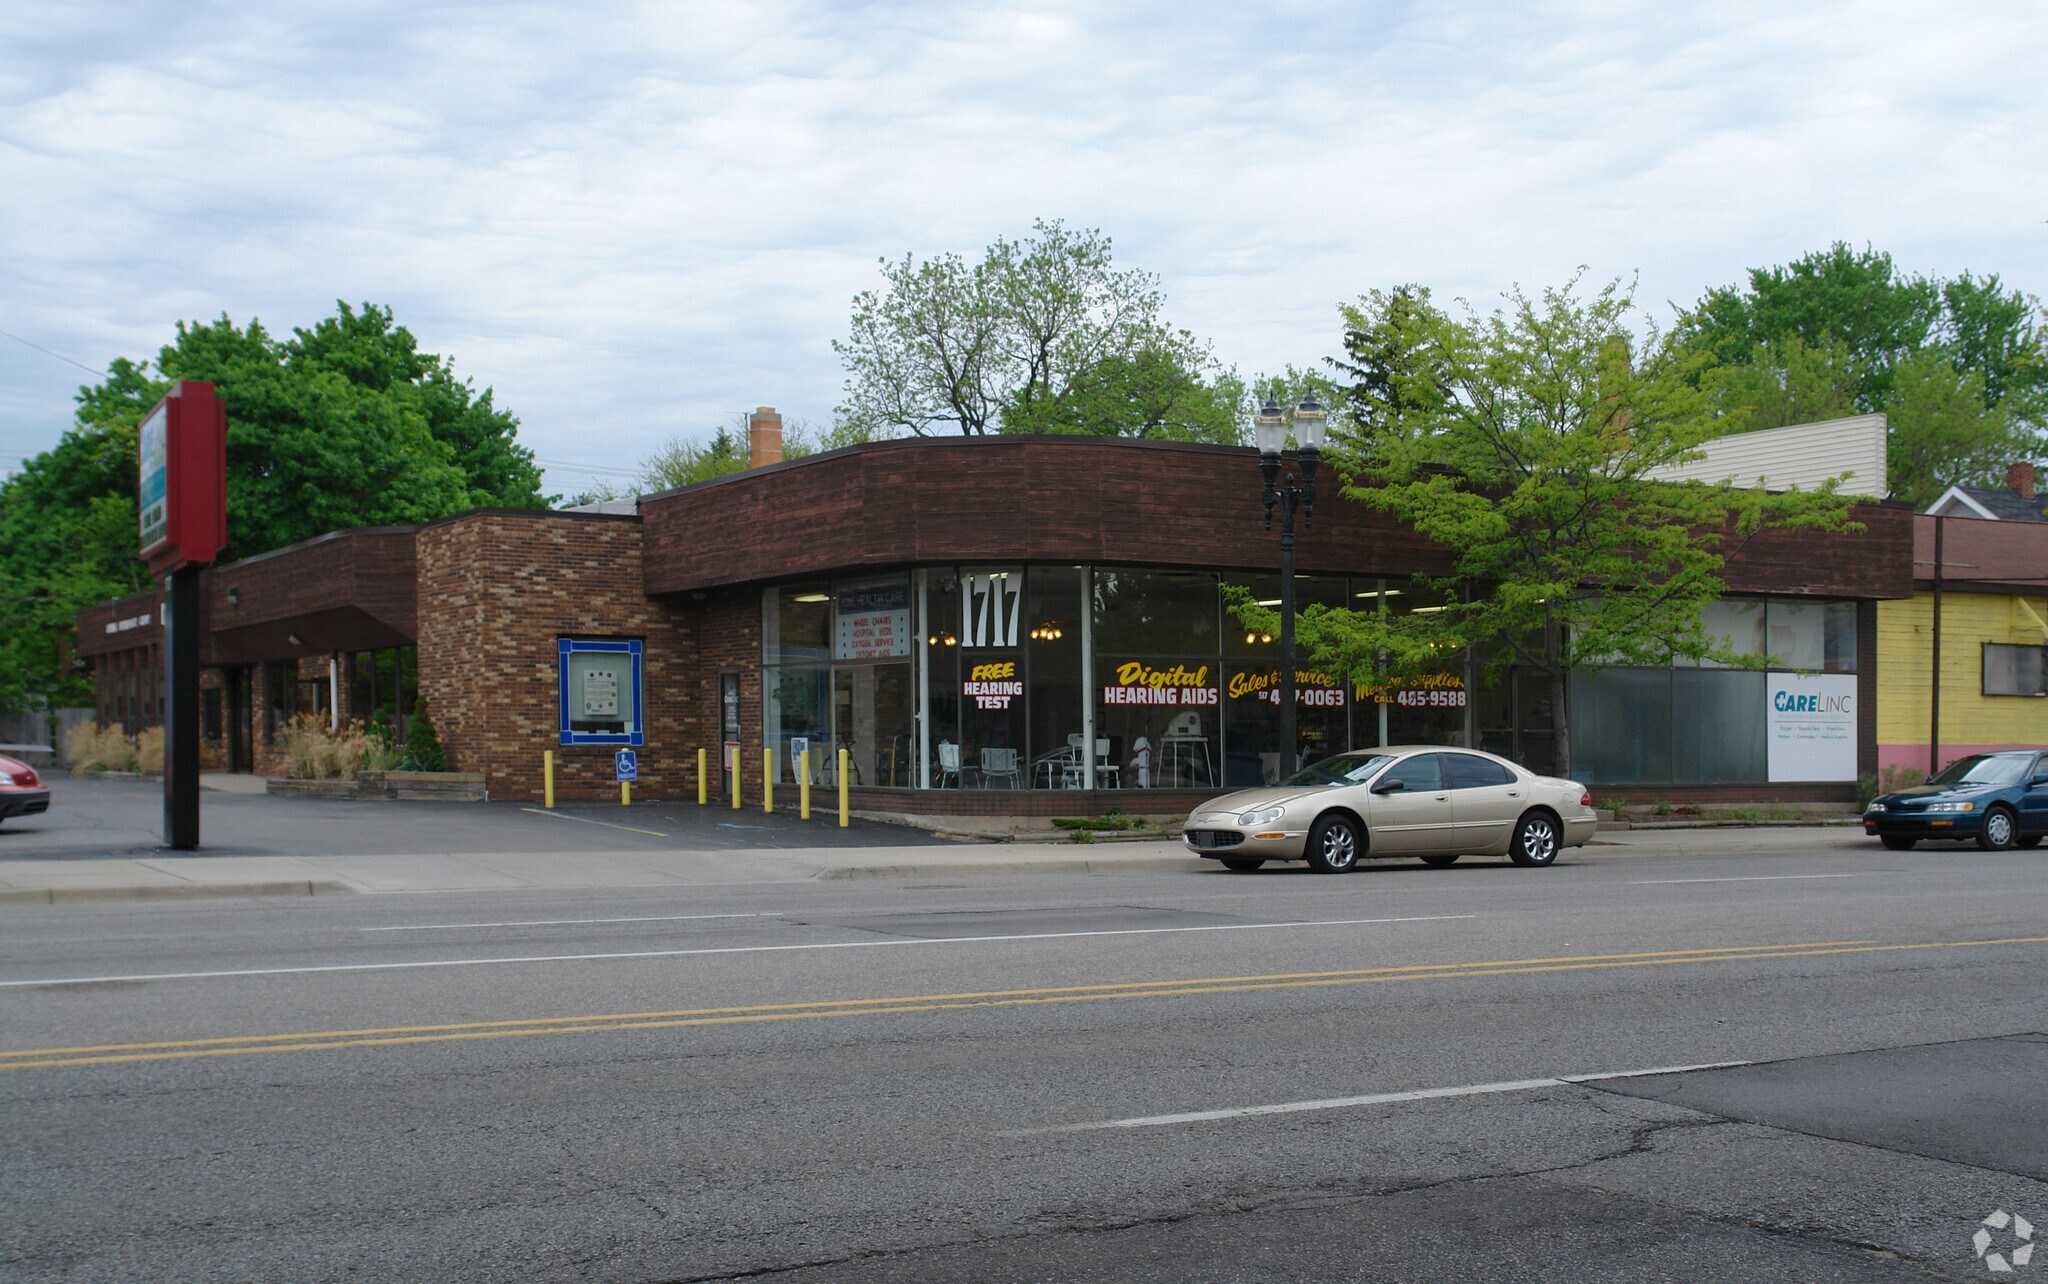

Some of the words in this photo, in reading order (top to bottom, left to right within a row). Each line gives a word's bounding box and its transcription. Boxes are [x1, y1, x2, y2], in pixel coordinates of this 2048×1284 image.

[961, 573, 1022, 647] 1717
[971, 662, 1016, 682] FREE
[1116, 661, 1208, 689] Digital
[963, 681, 1023, 696] HEARING
[1229, 672, 1268, 698] Sales
[1279, 671, 1335, 687] rvice
[975, 695, 1011, 709] TEST
[1103, 686, 1178, 705] HEARING
[1180, 687, 1218, 705] AIDS
[1258, 691, 1268, 700] 517
[1270, 689, 1345, 706] 47-0063
[1374, 694, 1395, 703] CALL
